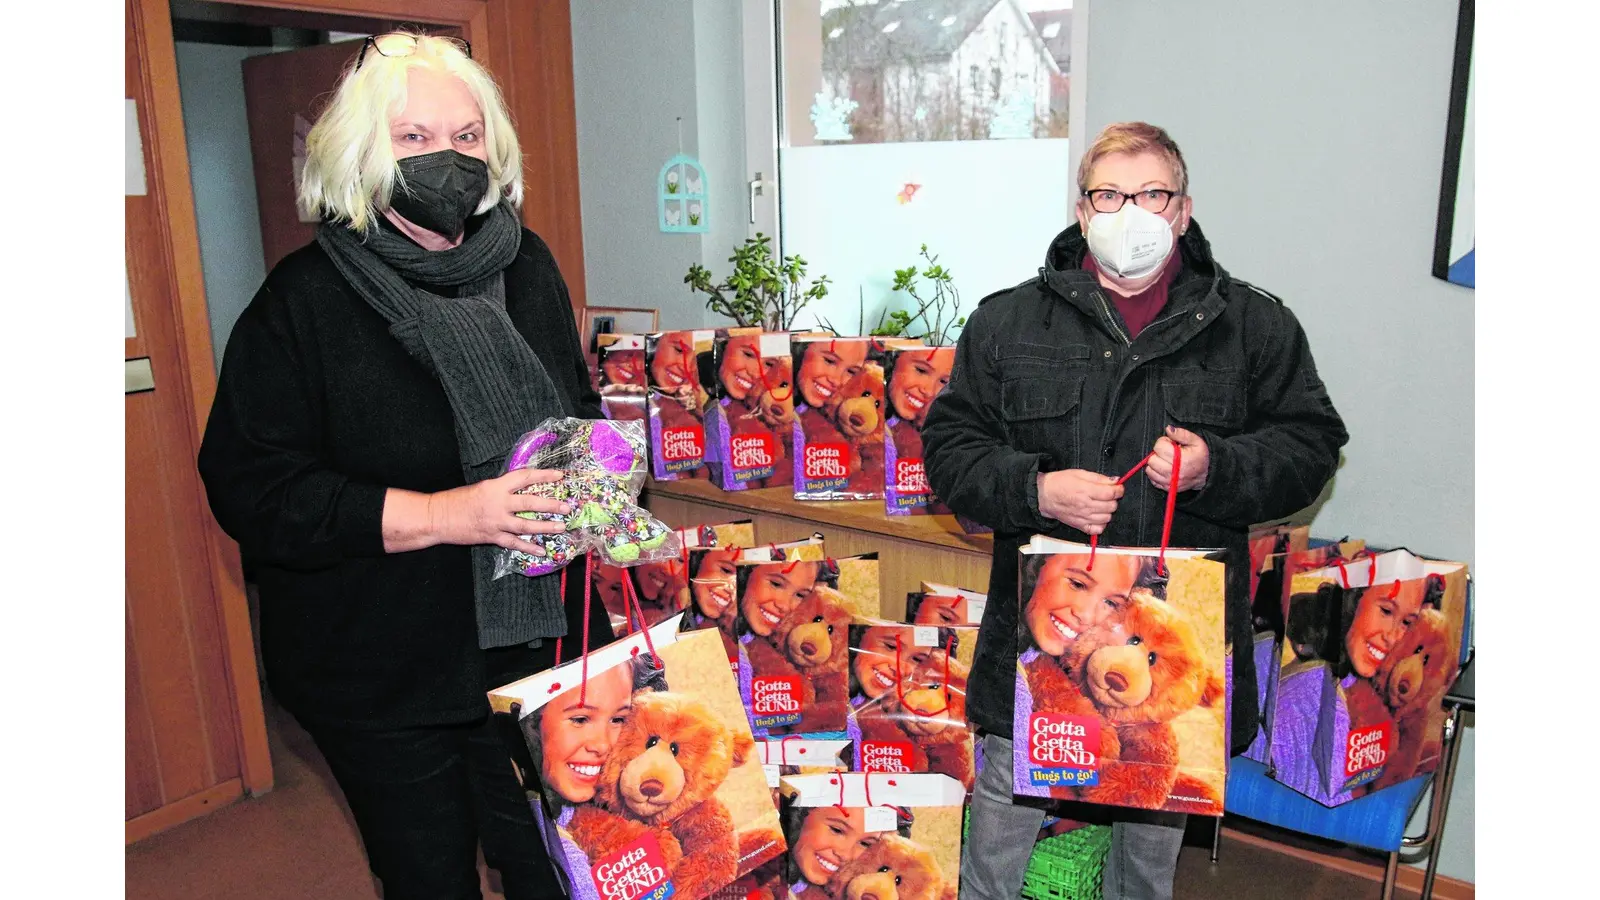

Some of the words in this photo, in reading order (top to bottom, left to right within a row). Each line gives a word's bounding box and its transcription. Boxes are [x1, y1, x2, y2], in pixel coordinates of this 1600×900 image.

[664, 430, 695, 441] Gotta
[664, 440, 694, 450] Getta
[732, 438, 764, 449] Gotta
[665, 446, 702, 458] GUND
[733, 447, 764, 458] Getta
[806, 446, 840, 457] Gotta
[734, 454, 772, 467] GUND
[806, 456, 839, 467] Getta
[898, 461, 925, 472] Gott
[806, 465, 846, 476] GUND
[898, 471, 928, 482] Gett
[897, 480, 930, 491] GUN
[754, 680, 792, 692] Gotta
[754, 691, 791, 702] Getta
[755, 700, 800, 712] GUND
[756, 717, 776, 727] Hugs
[777, 715, 785, 723] to
[787, 713, 799, 723] go!
[1033, 717, 1086, 736] Gotta
[1032, 732, 1085, 751] Getta
[1349, 729, 1383, 748] Gotta
[863, 743, 903, 757] Gotta
[1032, 746, 1096, 766] GUND
[1348, 743, 1381, 761] Getta
[863, 754, 902, 767] Getta
[1347, 749, 1386, 773] GUND
[1033, 770, 1060, 785] Hugs
[1062, 770, 1075, 780] to
[1077, 769, 1094, 785] go!
[1166, 794, 1214, 804] www.gund.com
[736, 839, 777, 864] www.gund.com
[596, 847, 647, 883] Gotta
[602, 862, 652, 896] Getta
